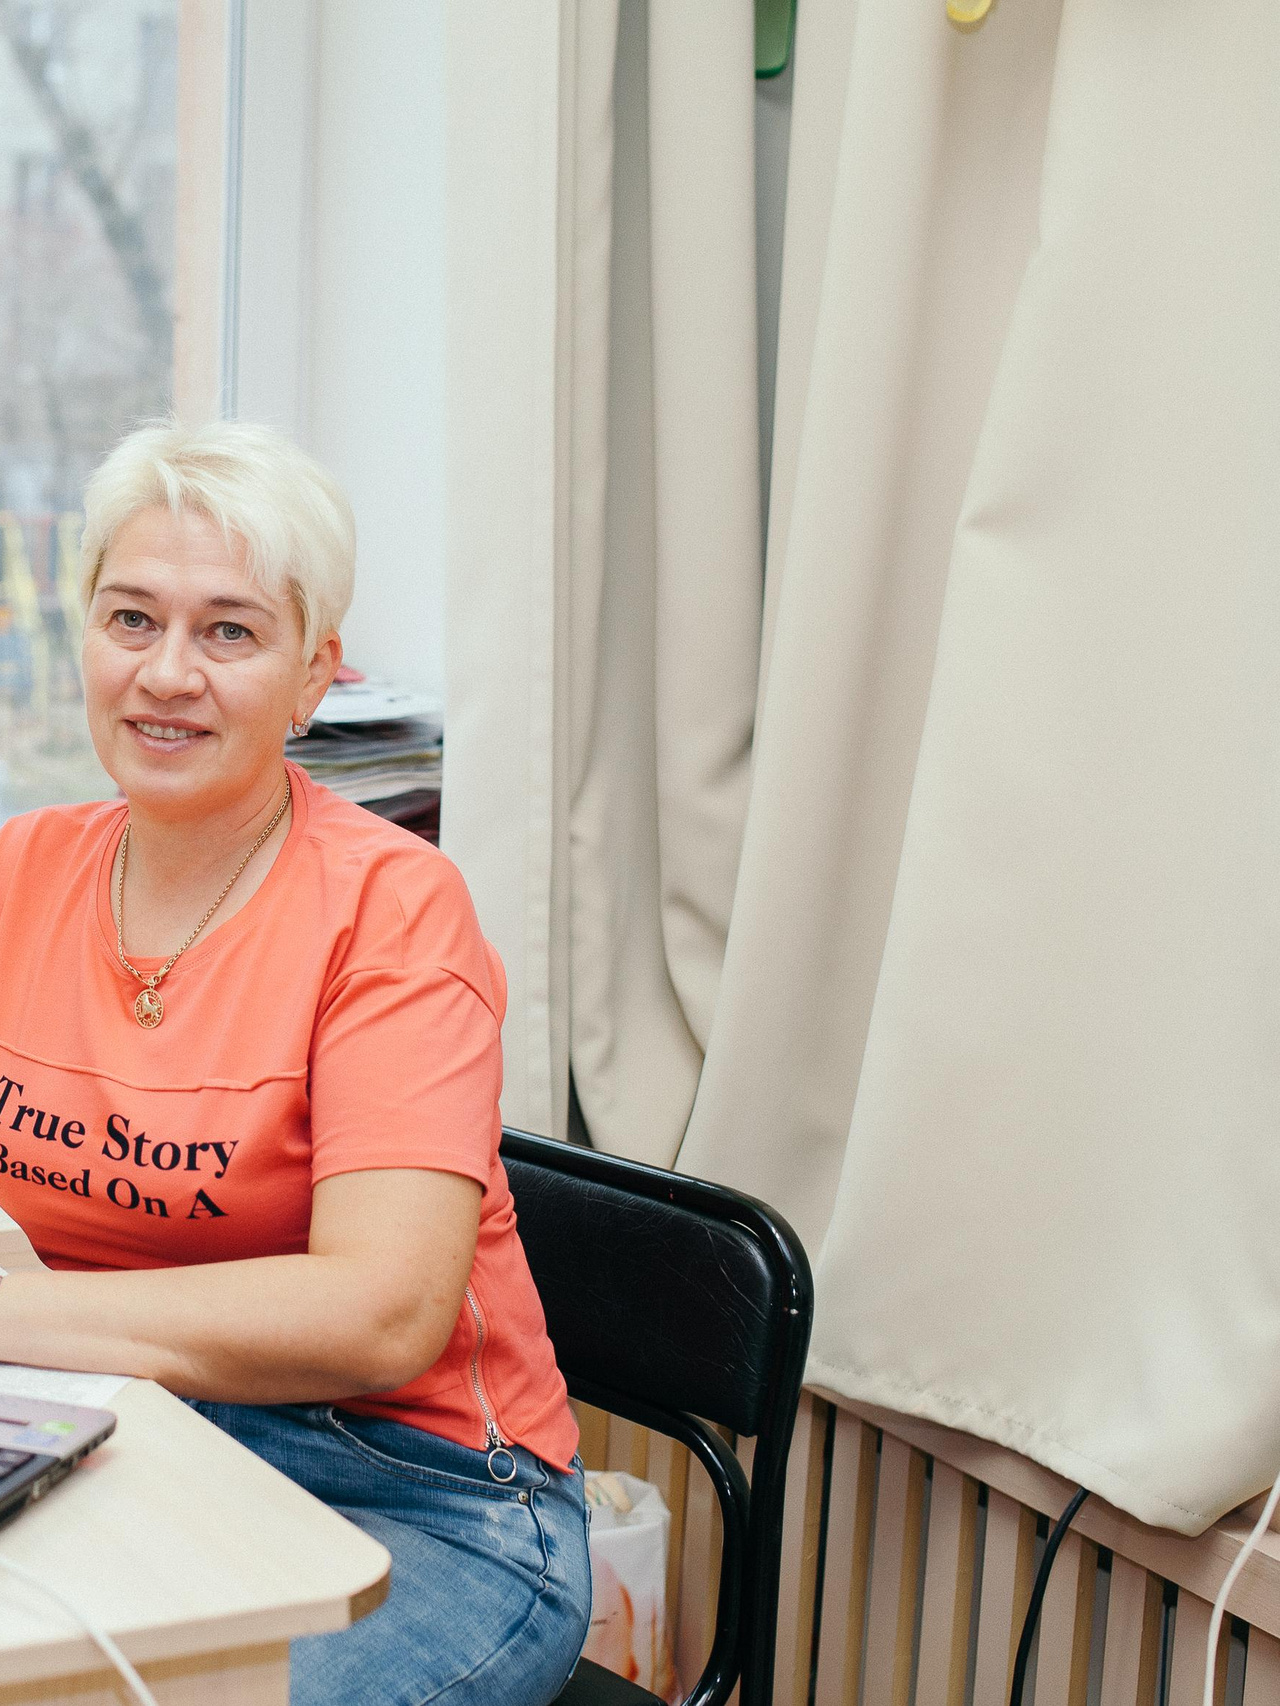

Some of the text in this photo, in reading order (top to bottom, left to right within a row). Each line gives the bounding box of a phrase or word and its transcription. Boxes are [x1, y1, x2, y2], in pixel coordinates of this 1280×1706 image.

[102, 1113, 239, 1179] Story
[106, 1177, 170, 1219] On
[185, 1188, 229, 1219] A
